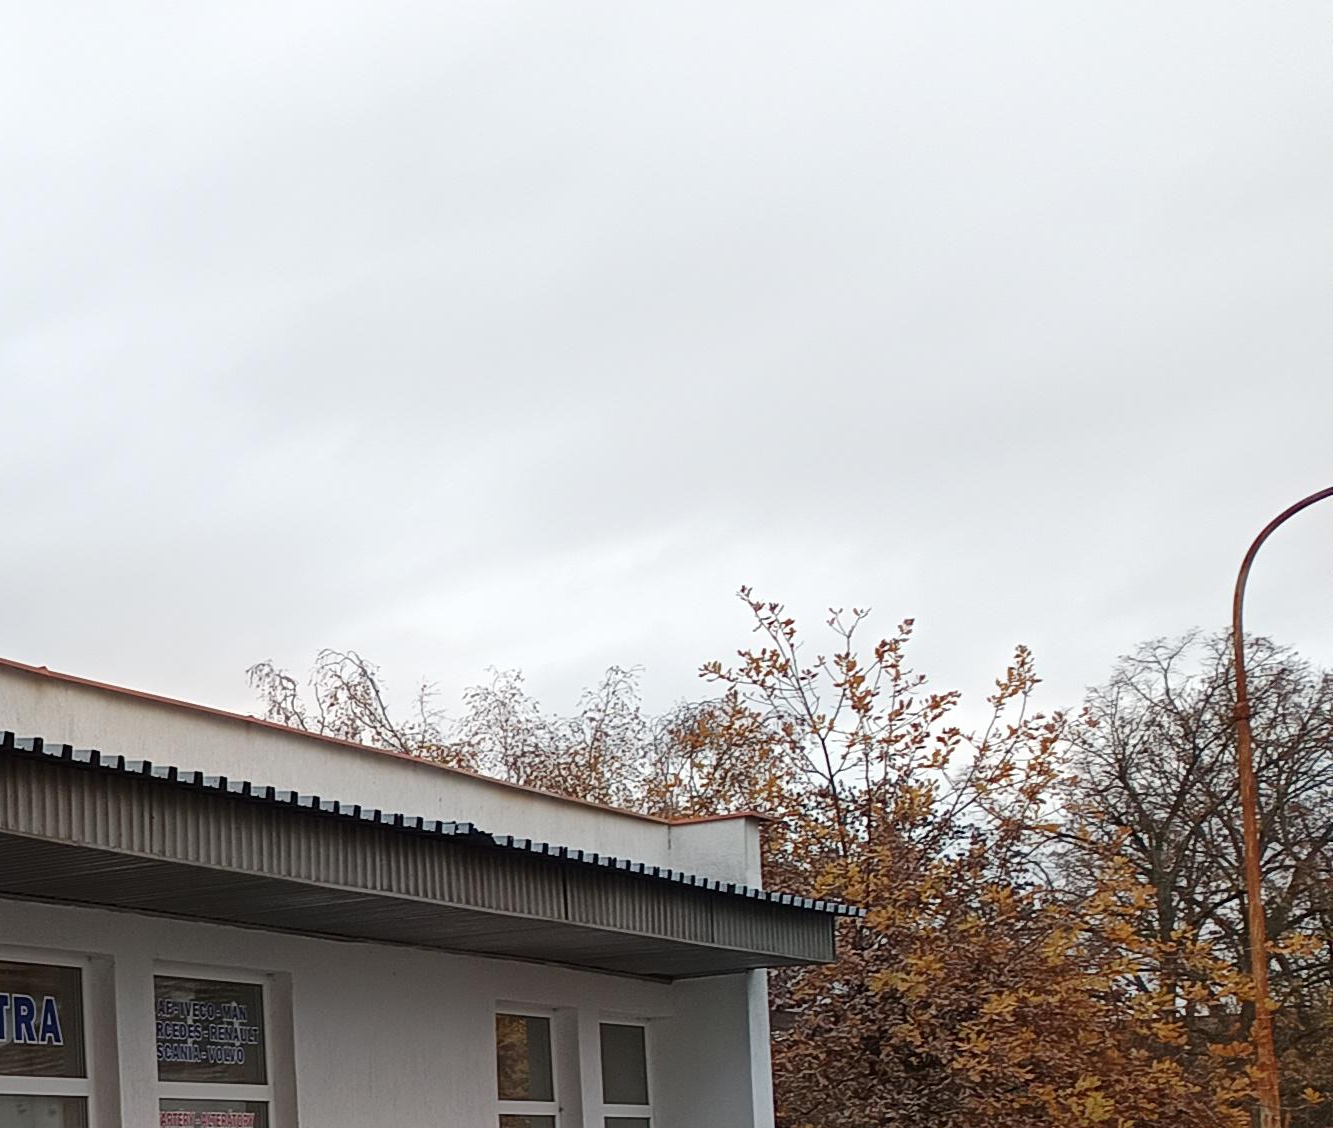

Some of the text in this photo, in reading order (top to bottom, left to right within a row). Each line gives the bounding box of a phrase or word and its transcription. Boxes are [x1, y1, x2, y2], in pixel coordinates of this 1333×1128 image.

[156, 1021, 202, 1041] RCEDES
[156, 1042, 201, 1063] SCANIA
[206, 1045, 245, 1064] VOLVO
